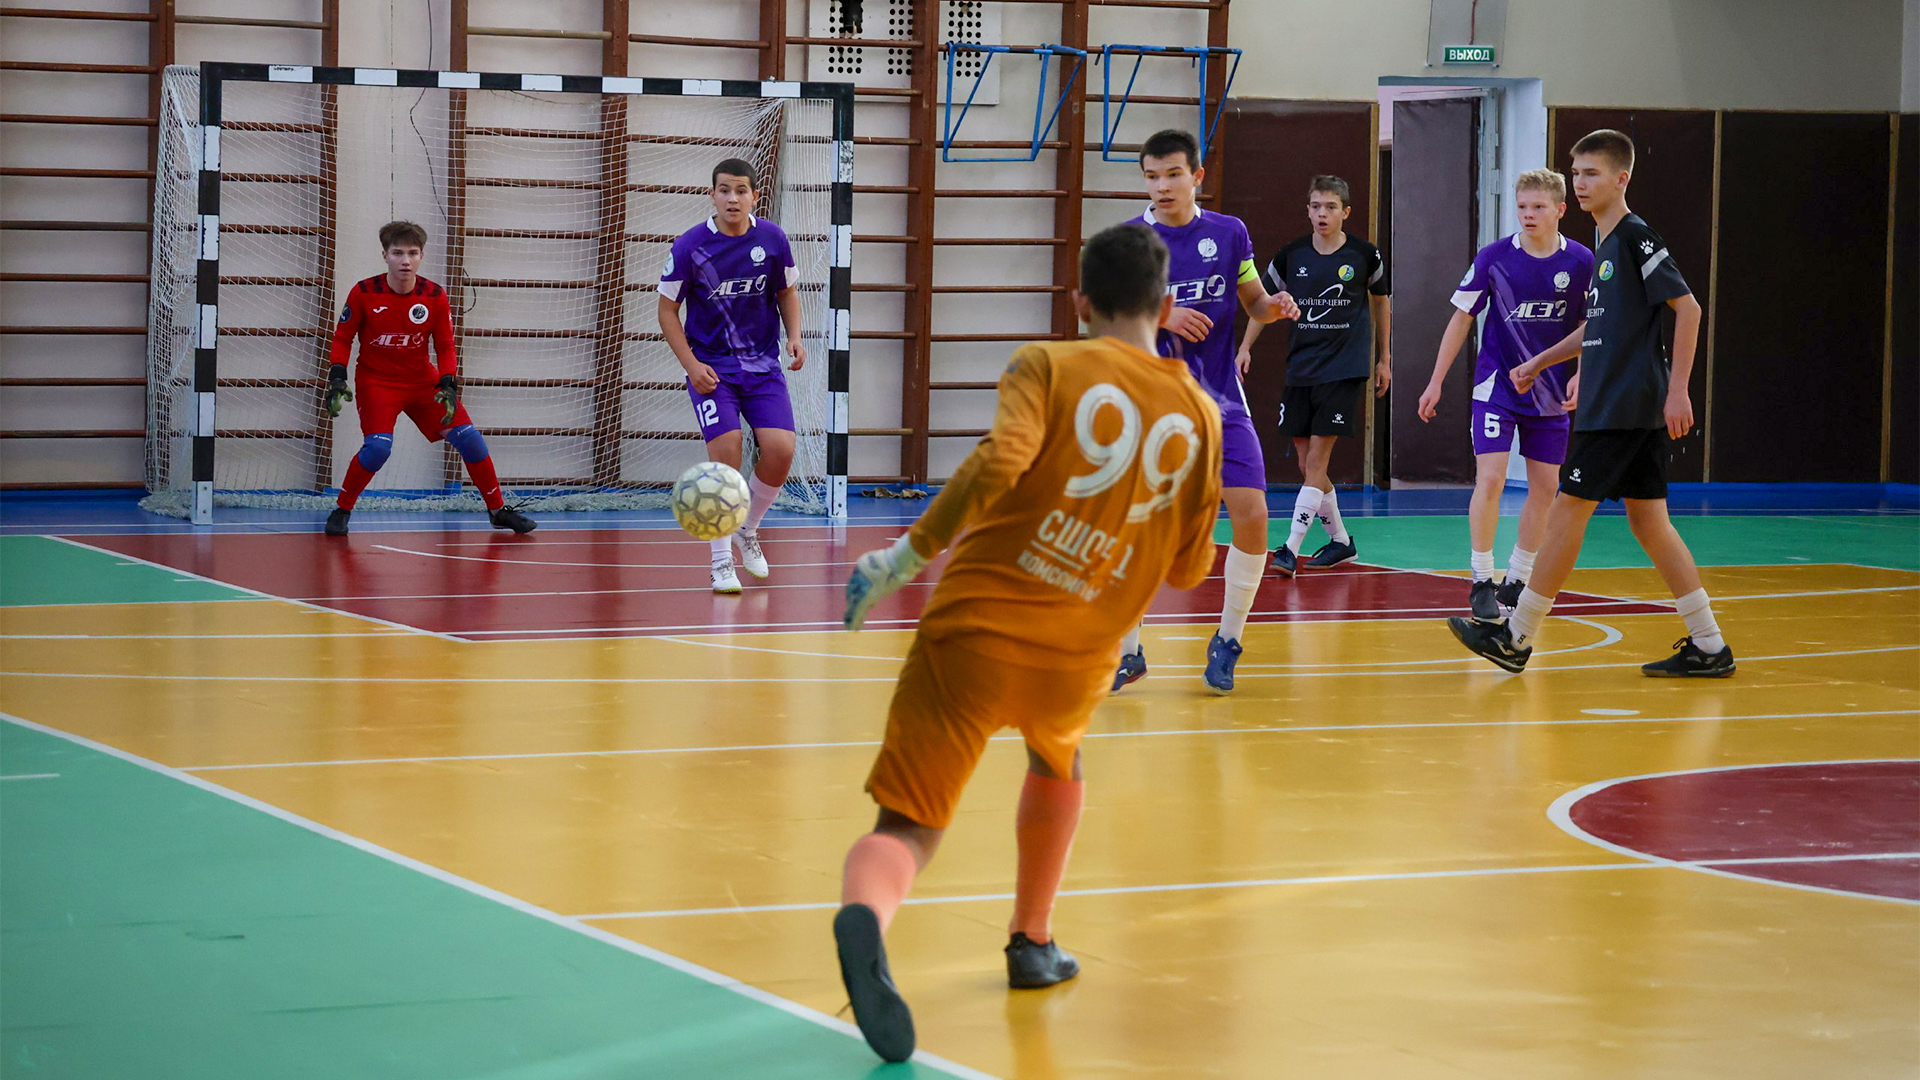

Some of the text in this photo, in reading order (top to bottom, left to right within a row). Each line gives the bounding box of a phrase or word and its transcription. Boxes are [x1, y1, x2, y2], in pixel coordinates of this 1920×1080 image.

[1449, 49, 1490, 61] ВЫХОД
[706, 279, 753, 300] АСЗ
[1165, 281, 1205, 303] СЗ
[1298, 297, 1352, 307] БОЙЛЕР-ЦЕНТР
[1504, 302, 1554, 322] АСЗ
[1297, 322, 1350, 330] группа компаний
[369, 334, 411, 347] АСЗ
[696, 398, 720, 428] 12
[1484, 412, 1500, 438] 5
[1064, 383, 1201, 523] 99
